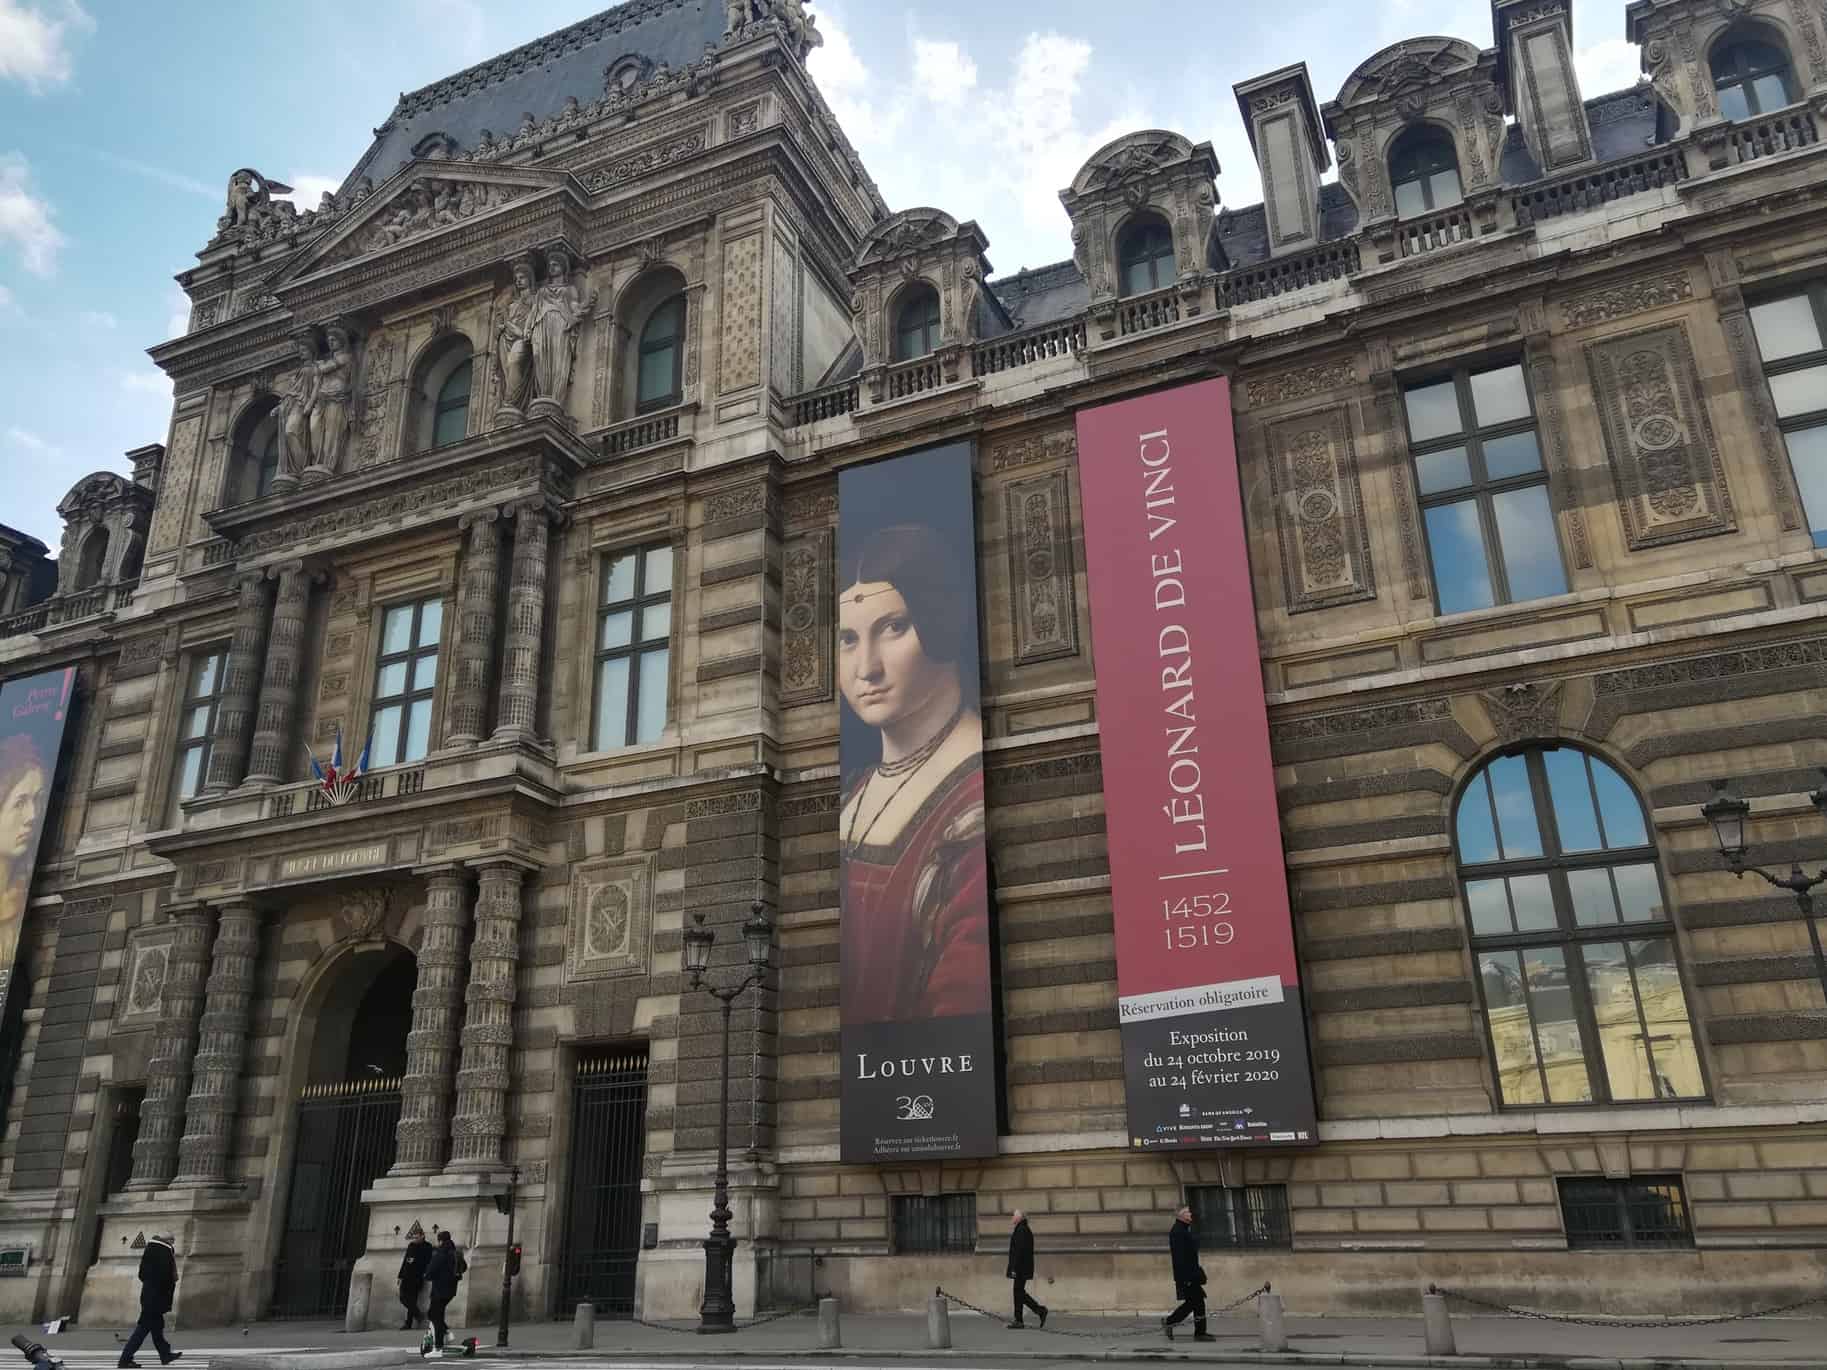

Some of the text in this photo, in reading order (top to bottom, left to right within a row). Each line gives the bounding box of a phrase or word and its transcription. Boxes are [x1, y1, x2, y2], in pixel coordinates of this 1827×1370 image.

[1139, 428, 1208, 854] LÉONARD DE VINCI
[1163, 893, 1232, 921] 1452
[1165, 922, 1234, 950] 1519
[1120, 986, 1270, 1017] Réservation obligatoire
[1169, 1027, 1249, 1049] Exposition
[857, 1053, 973, 1079] LOUVRE
[1144, 1048, 1280, 1069] du 24 octobre 2019
[1148, 1068, 1279, 1090] au 24 février 2020
